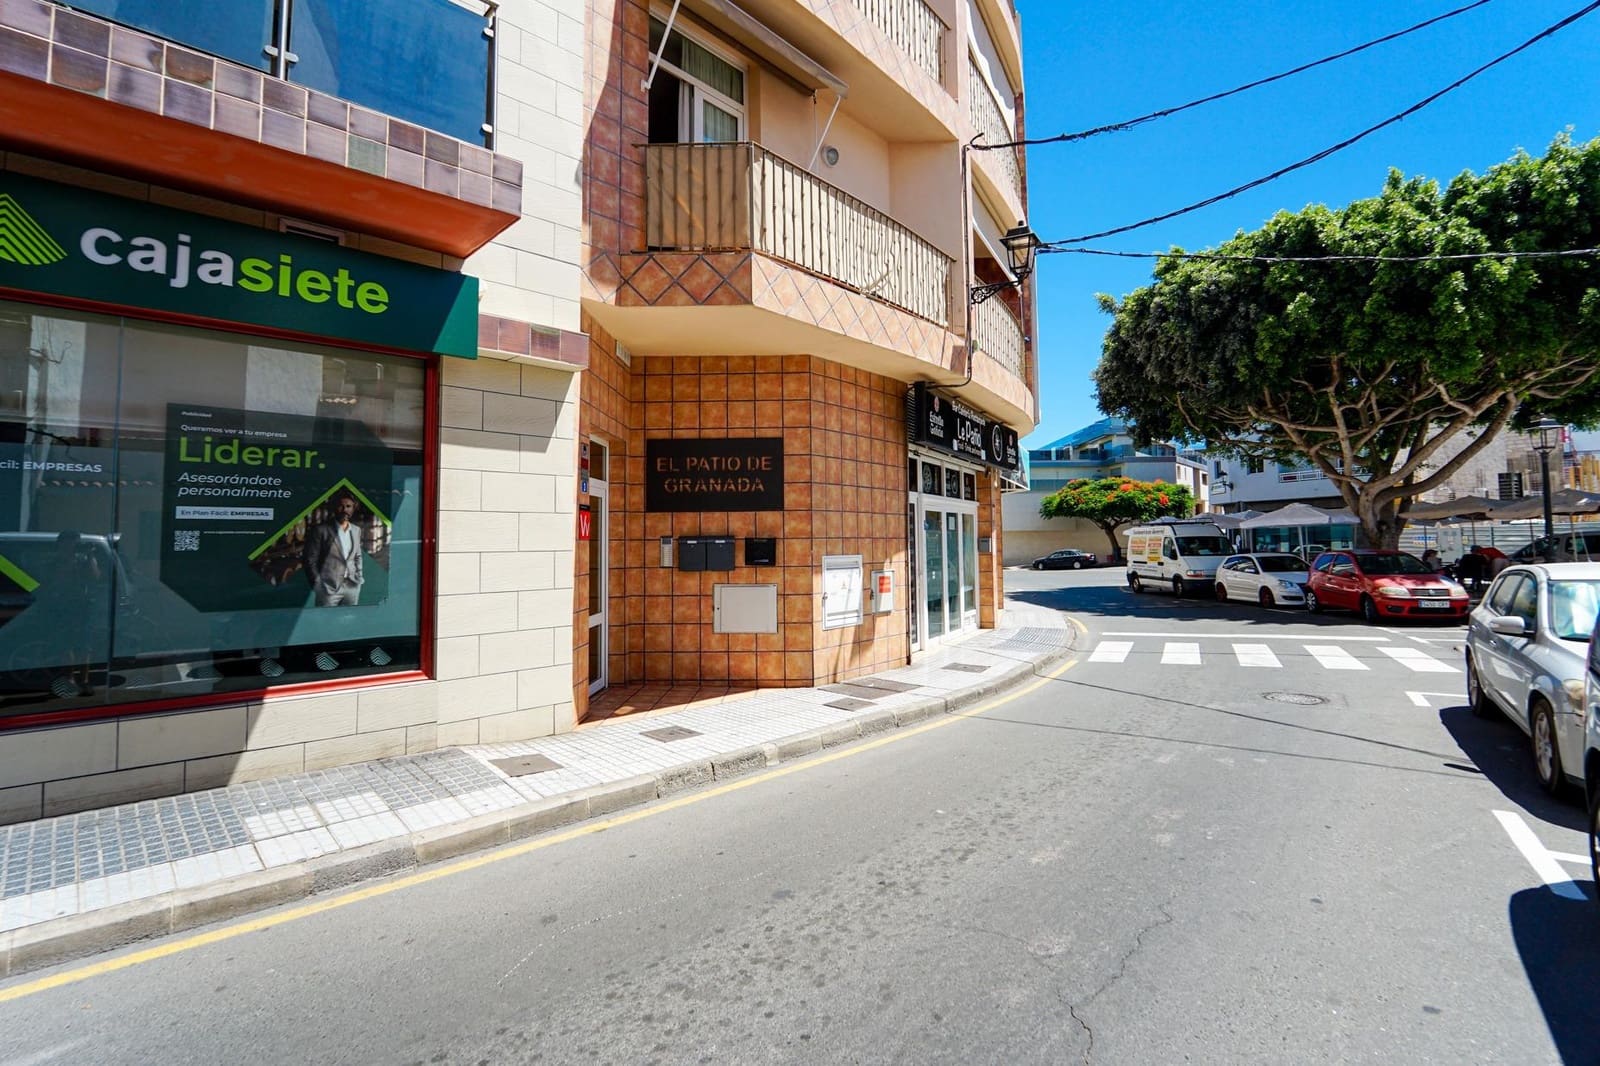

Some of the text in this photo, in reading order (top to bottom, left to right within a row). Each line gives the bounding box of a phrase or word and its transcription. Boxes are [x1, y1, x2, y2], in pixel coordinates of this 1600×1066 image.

[80, 227, 389, 314] cajasiete
[180, 424, 223, 434] Queremos
[179, 435, 326, 469] Liderar.
[23, 461, 103, 473] EMPRESAS
[656, 456, 773, 472] EL PATIO DE
[177, 472, 282, 486] Asesorándote
[664, 478, 765, 493] GRANADA
[177, 487, 292, 498] personalmente
